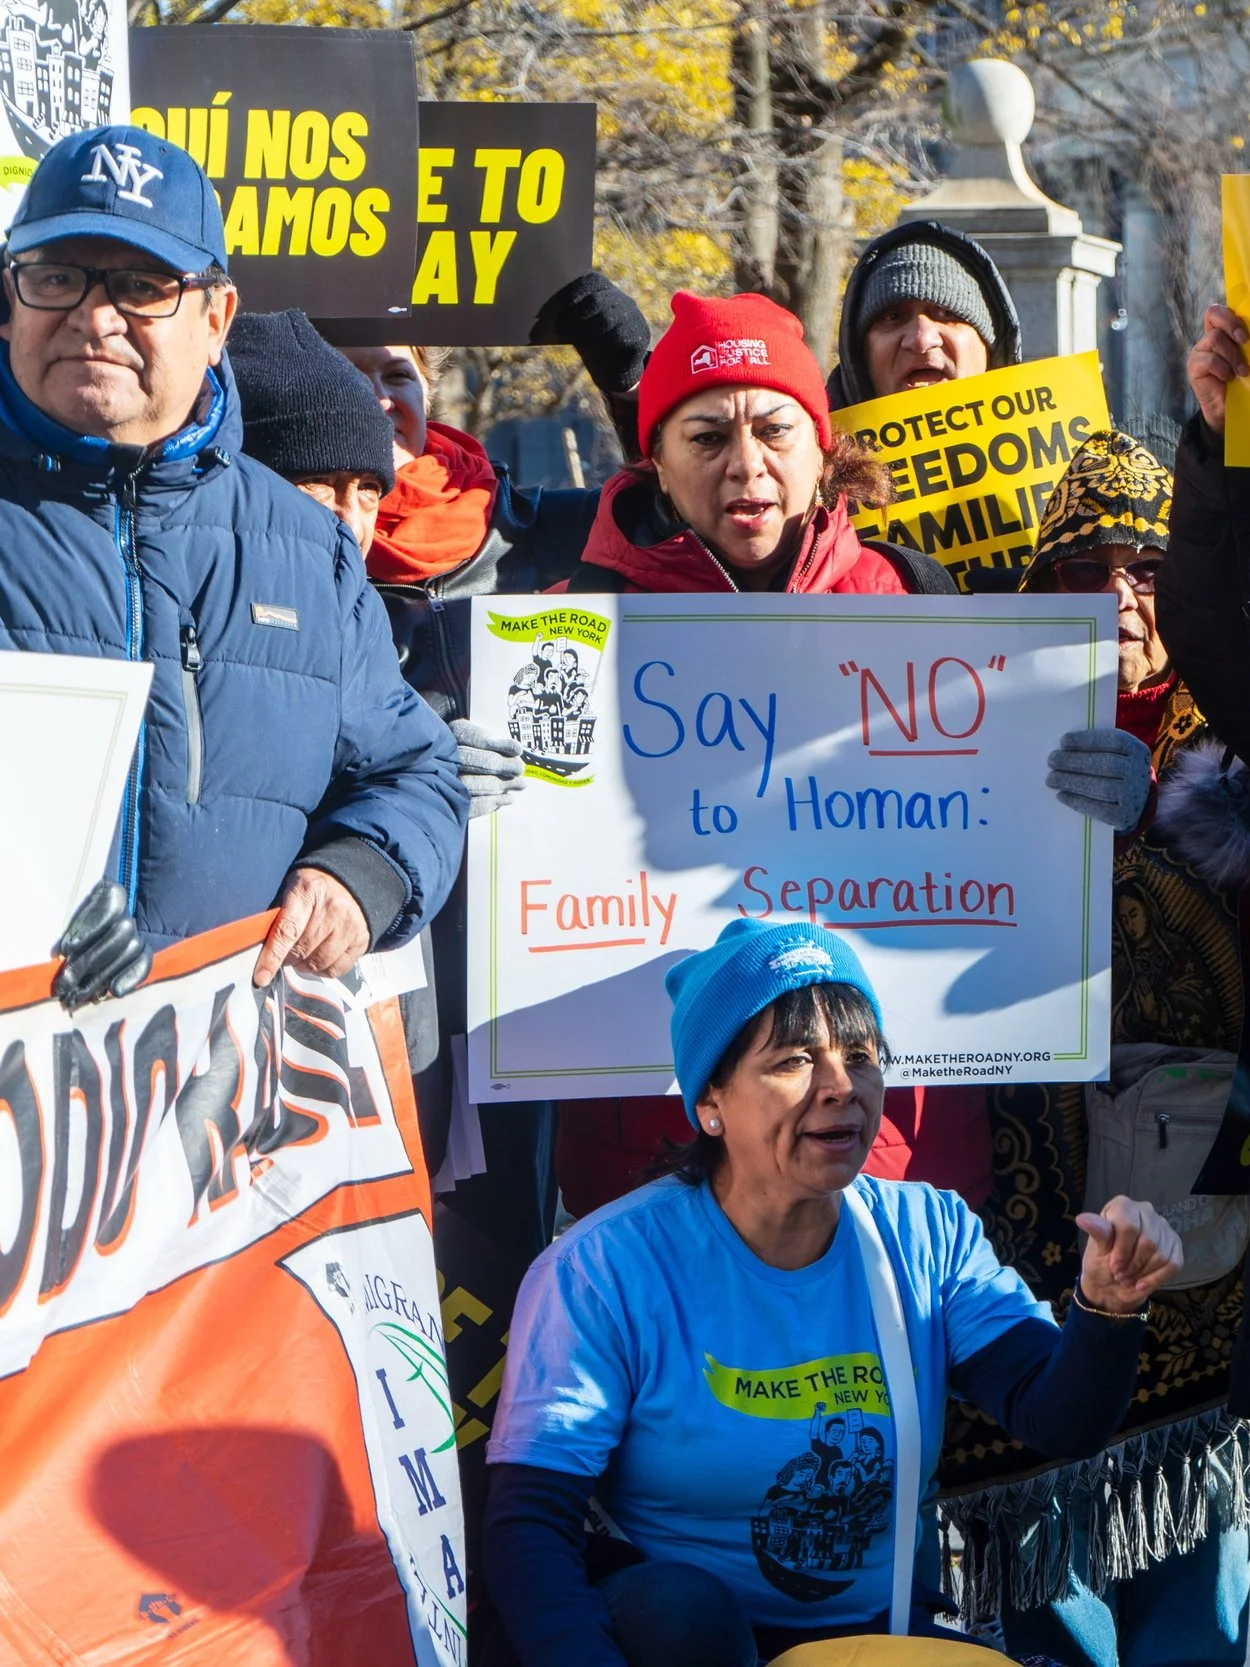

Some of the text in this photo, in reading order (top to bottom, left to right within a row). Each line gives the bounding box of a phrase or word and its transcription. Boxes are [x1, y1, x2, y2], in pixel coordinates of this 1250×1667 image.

[244, 110, 368, 181] NOS
[3, 166, 33, 177] DIGNID
[81, 143, 163, 208] NY
[474, 148, 565, 224] TO
[216, 186, 390, 257] AMOS
[411, 231, 518, 304] AY
[718, 339, 766, 349] HOUSING
[719, 348, 768, 358] JUSTICE
[720, 357, 771, 367] FOR ALL
[991, 386, 1057, 420] OUR
[501, 613, 607, 633] MAKE THE ROAD
[550, 626, 603, 644] NEW YORK
[623, 661, 776, 797] Say
[691, 776, 989, 835] to Homan:
[521, 865, 1014, 945] Family Separation
[900, 1066, 1013, 1079] @MaketheRoadNY
[735, 1366, 887, 1399] MAKE THE RO
[834, 1389, 868, 1405] NEW
